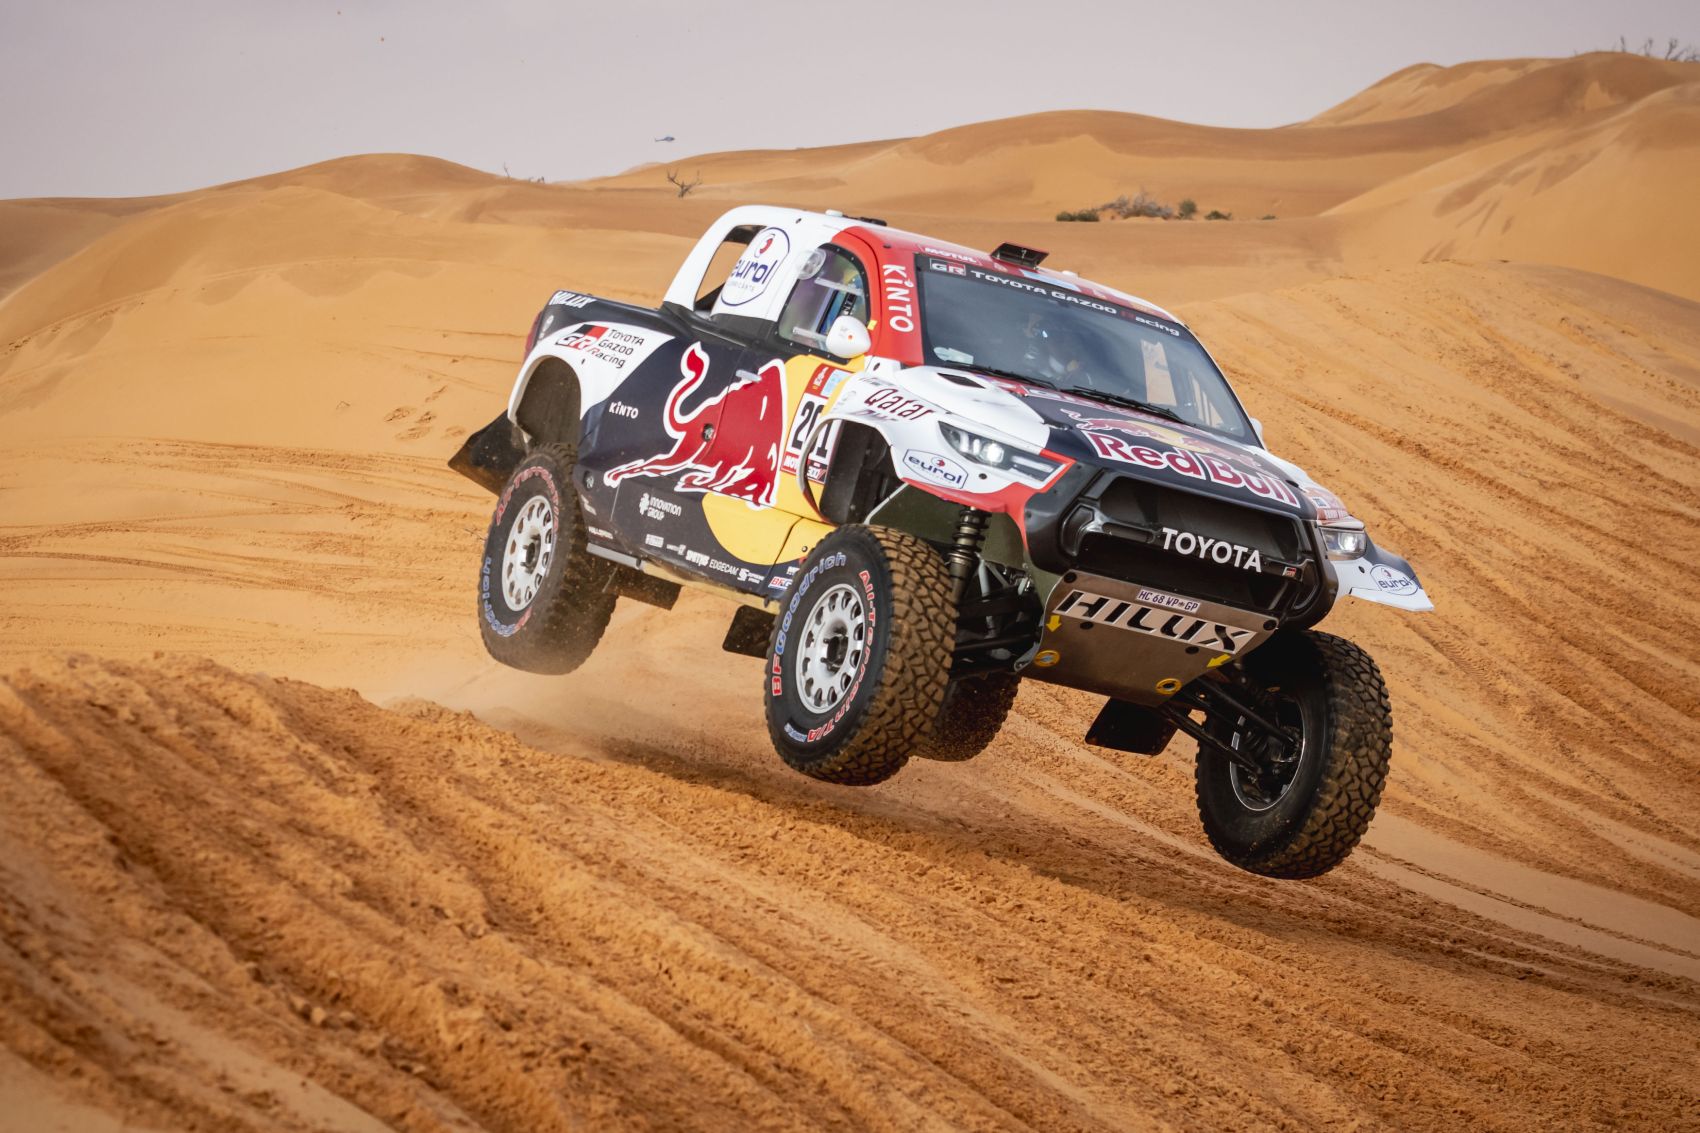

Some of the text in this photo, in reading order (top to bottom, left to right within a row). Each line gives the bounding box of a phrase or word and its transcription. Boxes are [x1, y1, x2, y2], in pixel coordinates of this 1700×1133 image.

[931, 262, 966, 276] GR
[970, 270, 1047, 294] TOYOTA
[1051, 291, 1117, 314] GAZOO
[598, 339, 634, 356] GAZOO
[609, 329, 645, 346] TOYOTA
[587, 347, 626, 369] Racing
[864, 388, 936, 421] Qatar
[908, 456, 962, 484] eurol
[1082, 430, 1301, 509] Red Bull
[1162, 527, 1262, 573] TOYOTA
[709, 559, 739, 576] EDGECAM
[771, 577, 792, 588] BFG
[1138, 591, 1199, 611] HC 68 WP GP
[1055, 590, 1250, 652] HILUX
